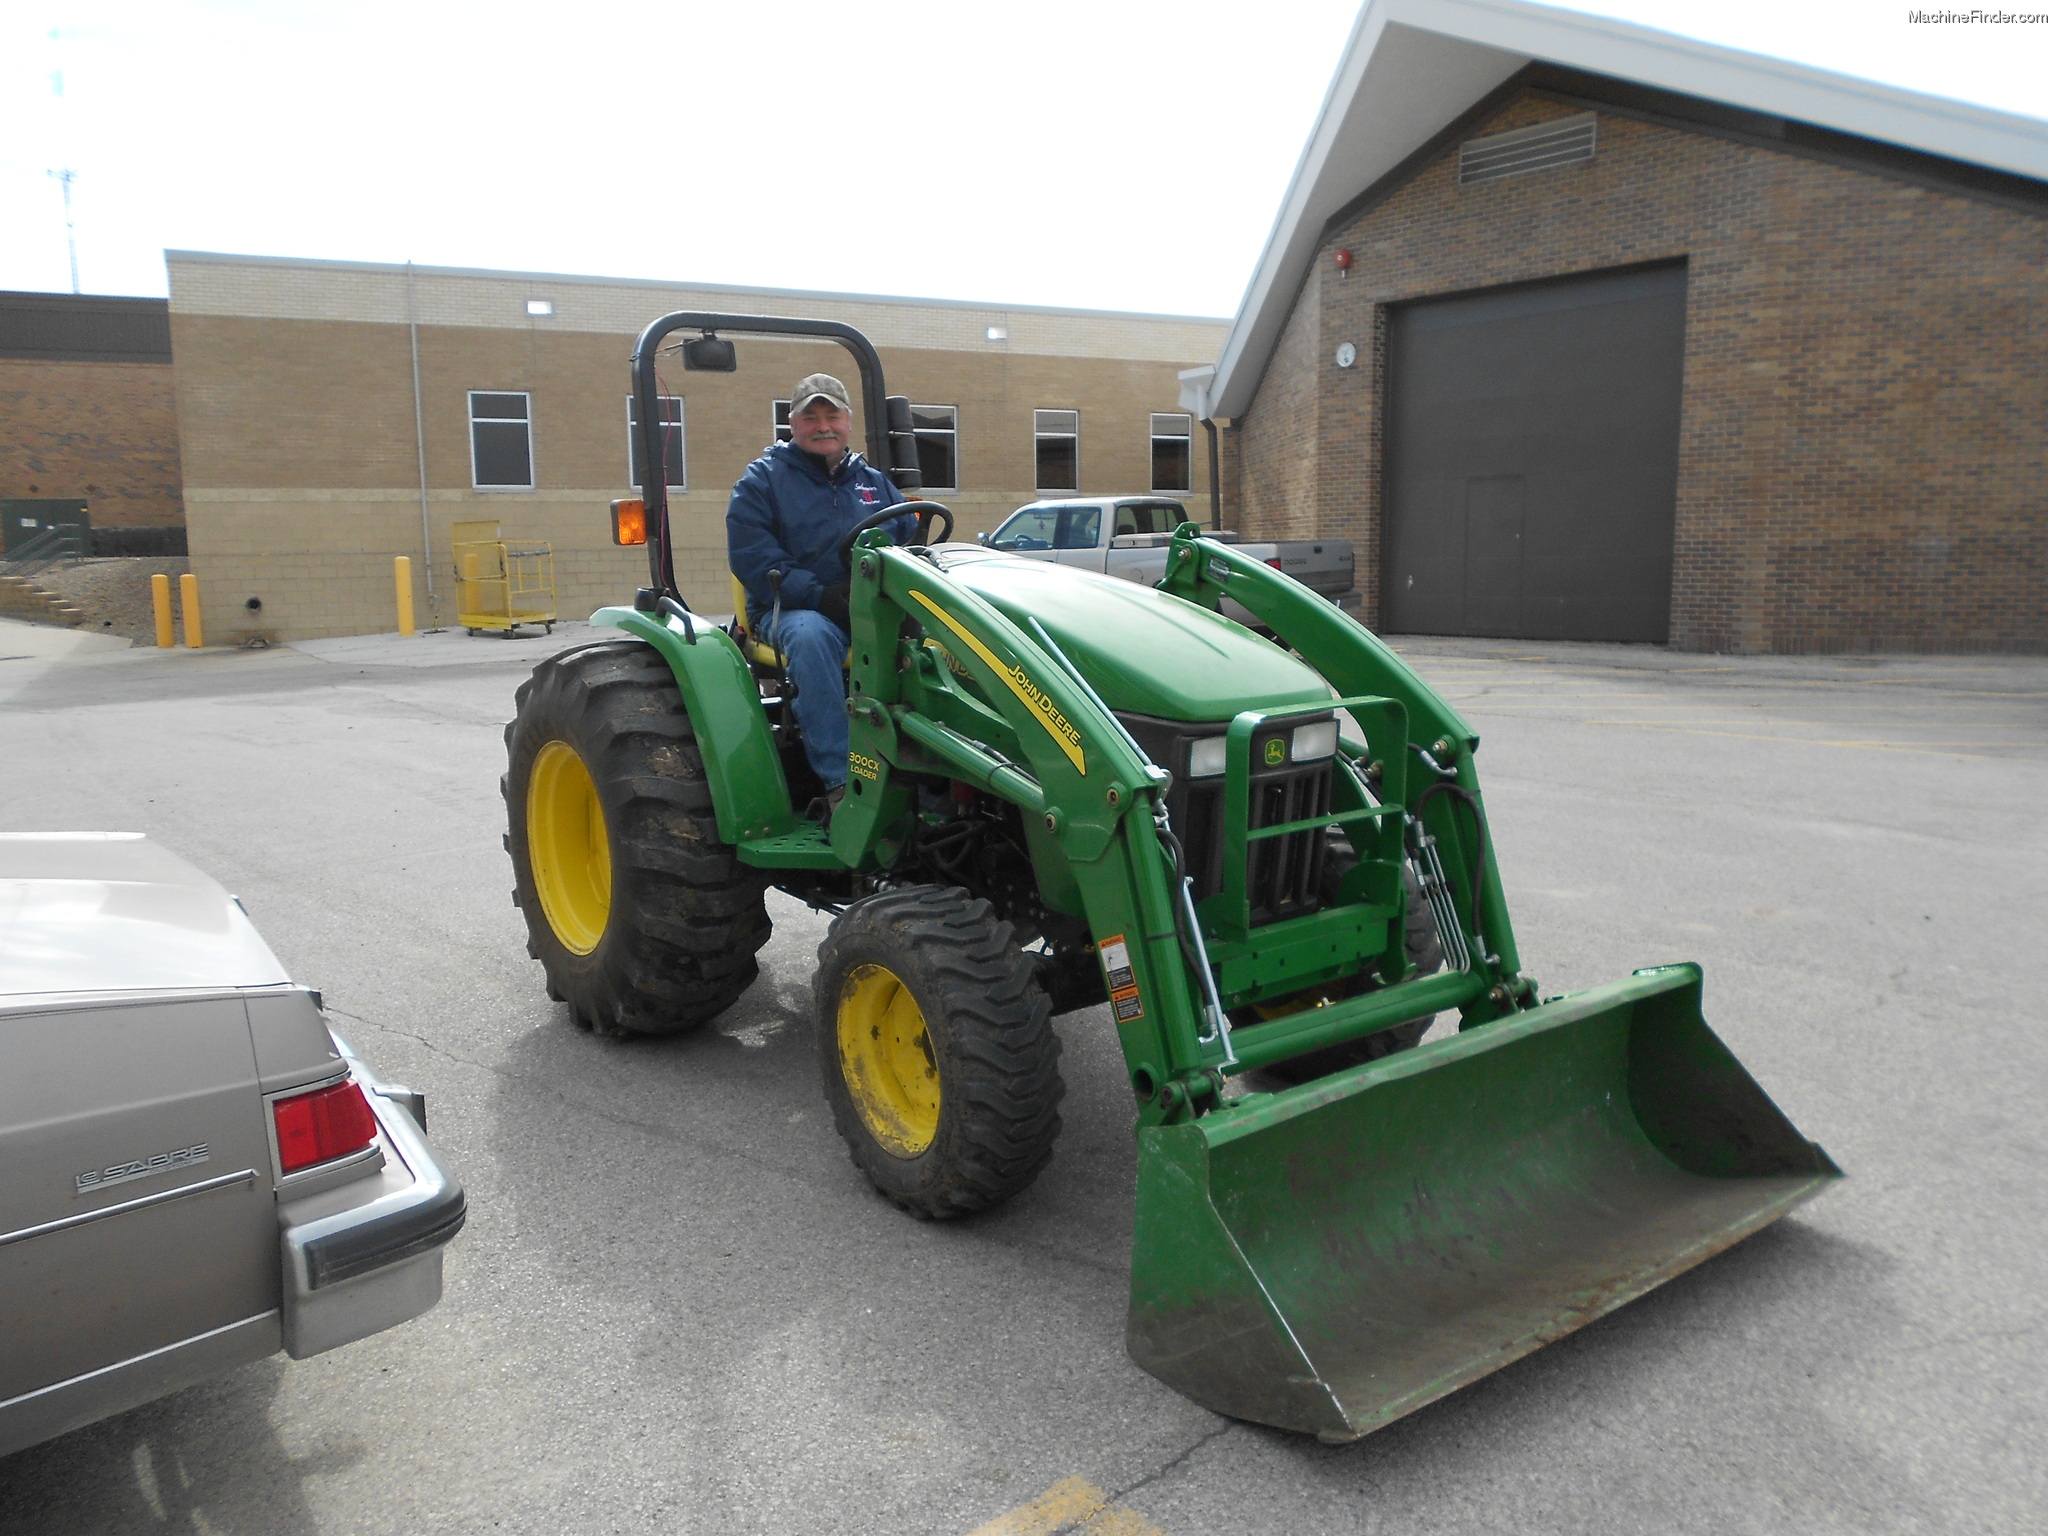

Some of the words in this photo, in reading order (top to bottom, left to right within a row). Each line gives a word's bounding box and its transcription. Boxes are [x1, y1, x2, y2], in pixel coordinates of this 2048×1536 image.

[1008, 665, 1041, 704] JOHN
[1038, 694, 1081, 746] DEERE
[849, 751, 880, 772] 300CX
[850, 764, 877, 781] LOADER
